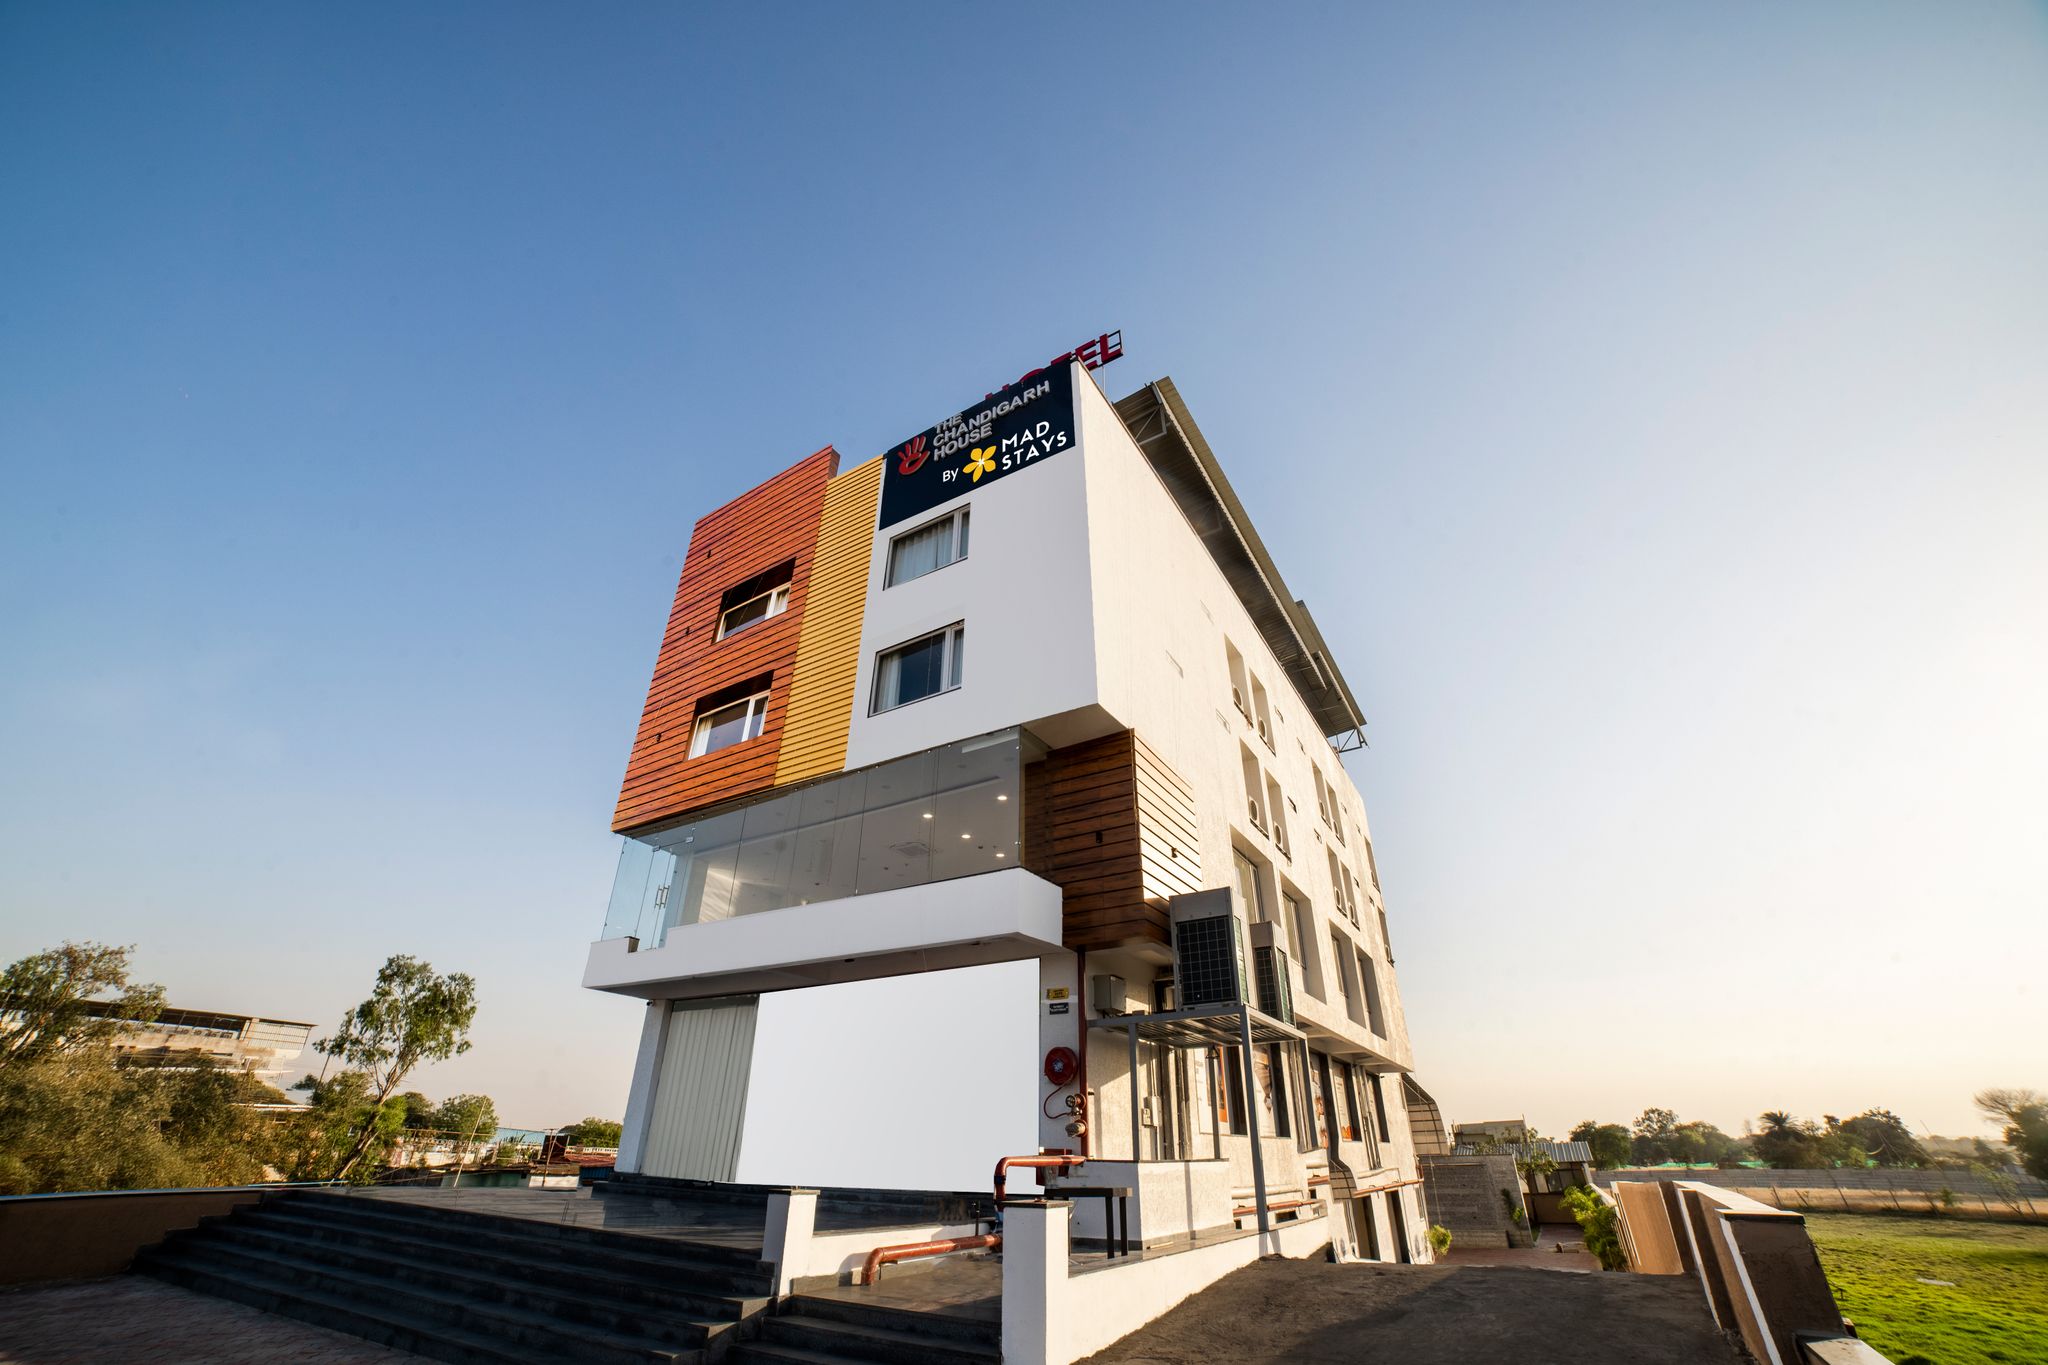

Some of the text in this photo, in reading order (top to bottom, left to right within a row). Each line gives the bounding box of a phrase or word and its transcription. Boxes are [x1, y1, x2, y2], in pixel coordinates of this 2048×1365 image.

[933, 380, 1050, 447] CHANDIGARH
[936, 412, 963, 434] THE
[934, 422, 993, 461] HOUSE
[1002, 421, 1050, 453] MAD
[1002, 431, 1067, 470] STAYS
